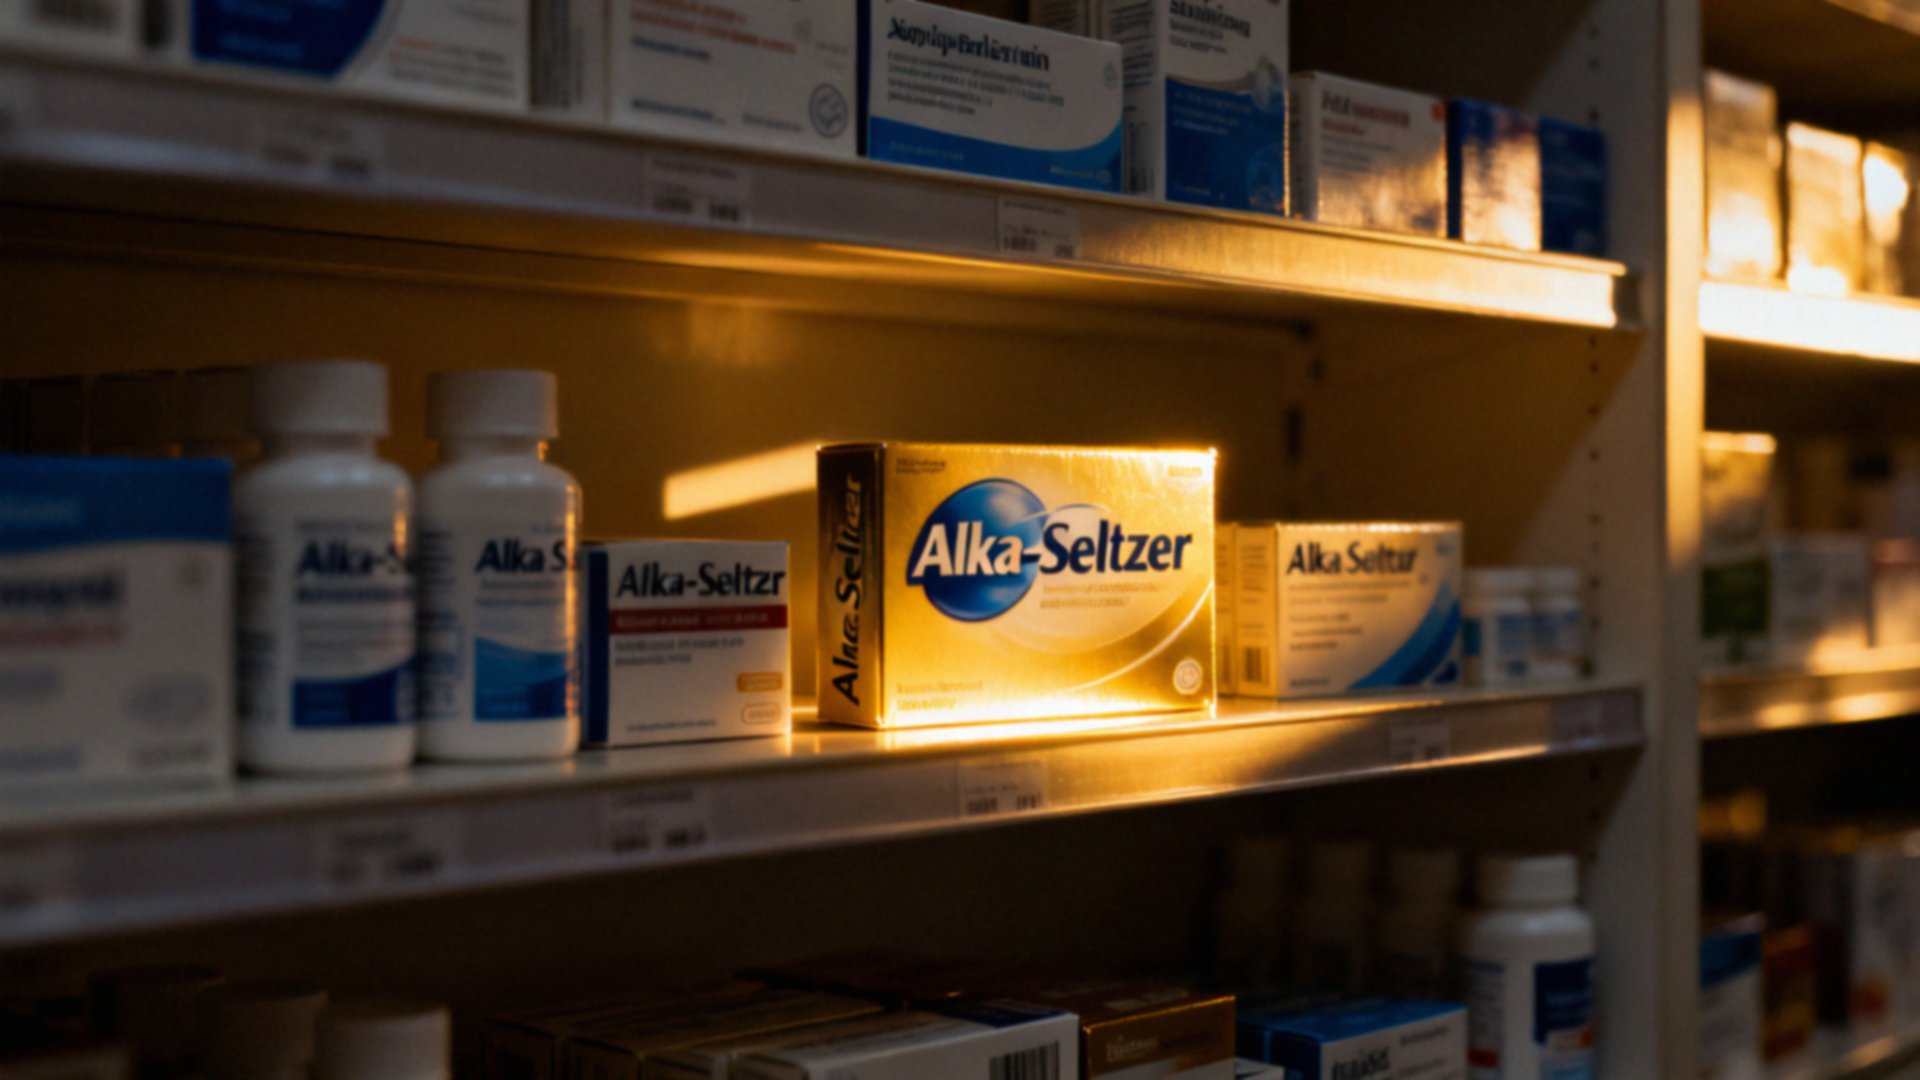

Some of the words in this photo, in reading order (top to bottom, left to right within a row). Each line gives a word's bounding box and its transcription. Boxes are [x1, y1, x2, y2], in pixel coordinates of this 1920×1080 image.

[475, 538, 544, 572] Alka
[911, 519, 1193, 577] Alka-Seltzer
[1286, 541, 1341, 574] Alka
[616, 562, 785, 597] Alka-Seltzr
